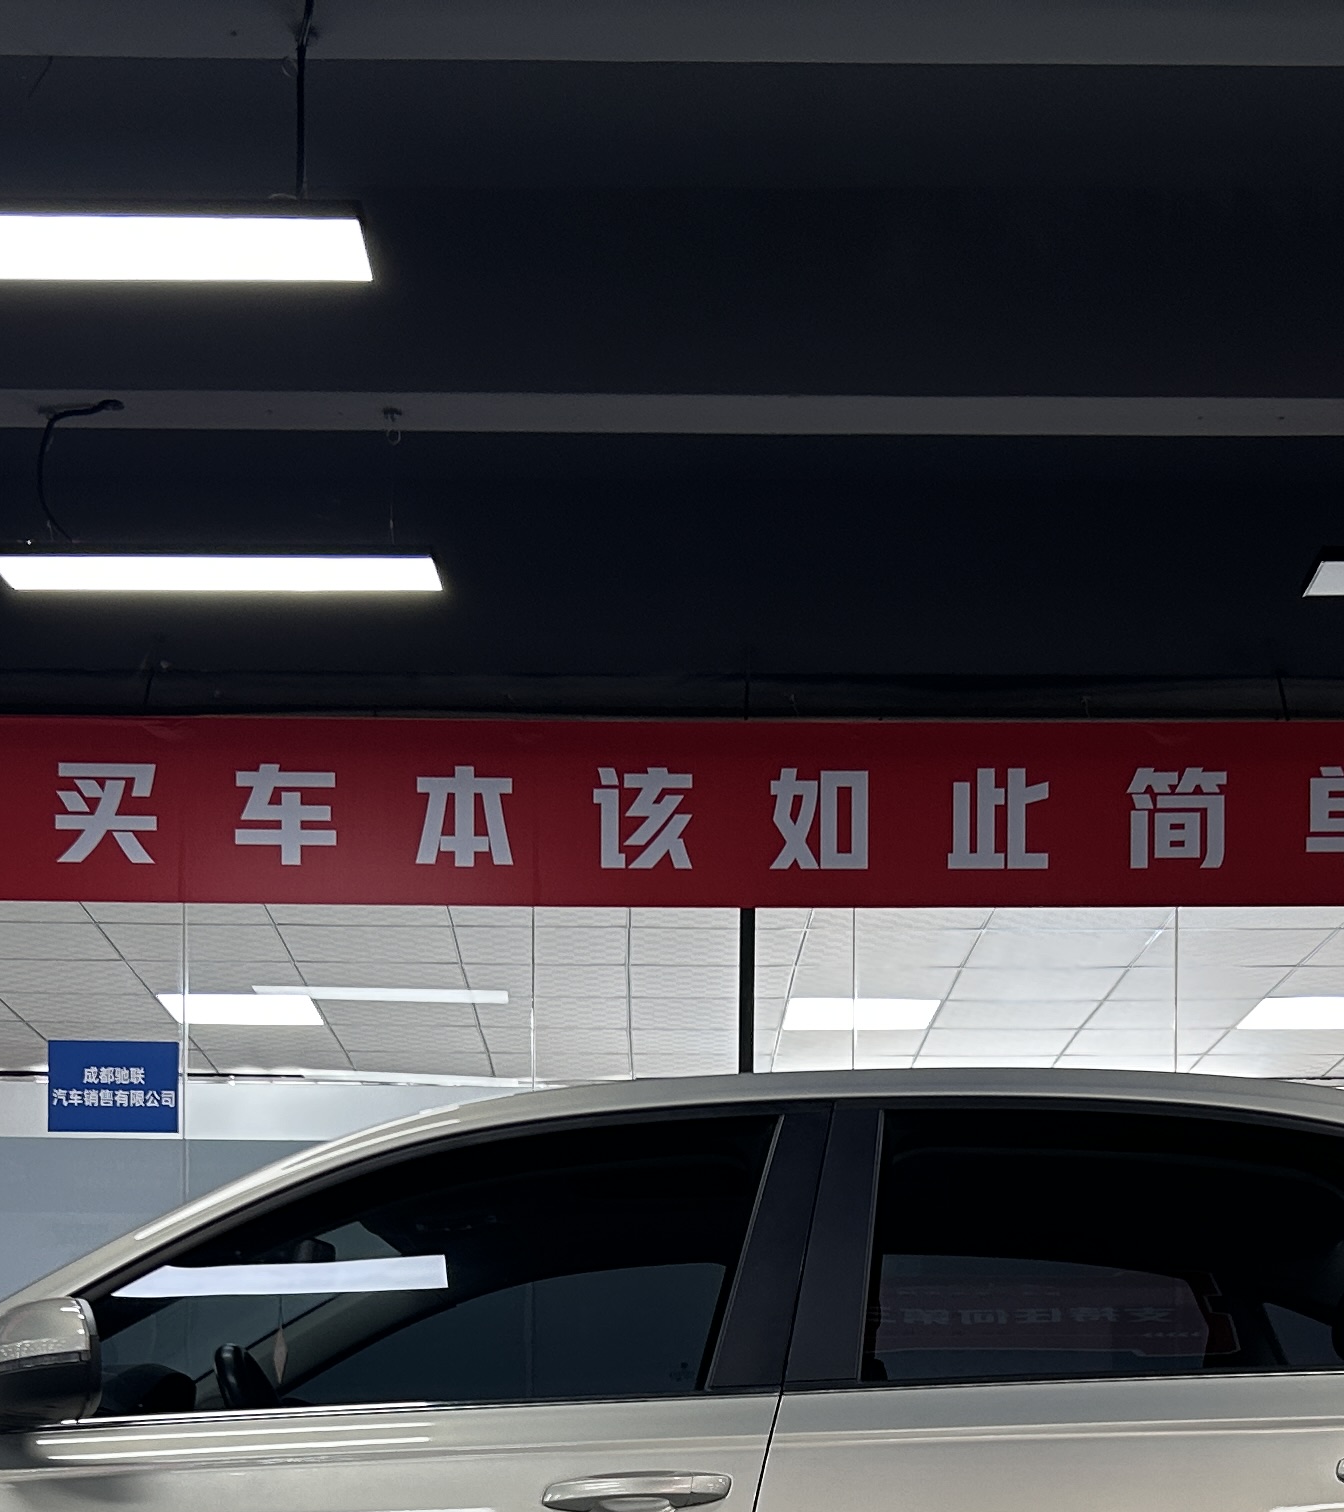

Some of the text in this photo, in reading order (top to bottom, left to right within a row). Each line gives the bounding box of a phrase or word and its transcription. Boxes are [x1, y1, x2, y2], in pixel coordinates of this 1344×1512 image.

[82, 1066, 146, 1085] 成都驰联
[52, 1088, 176, 1108] 汽车销售有限公司
